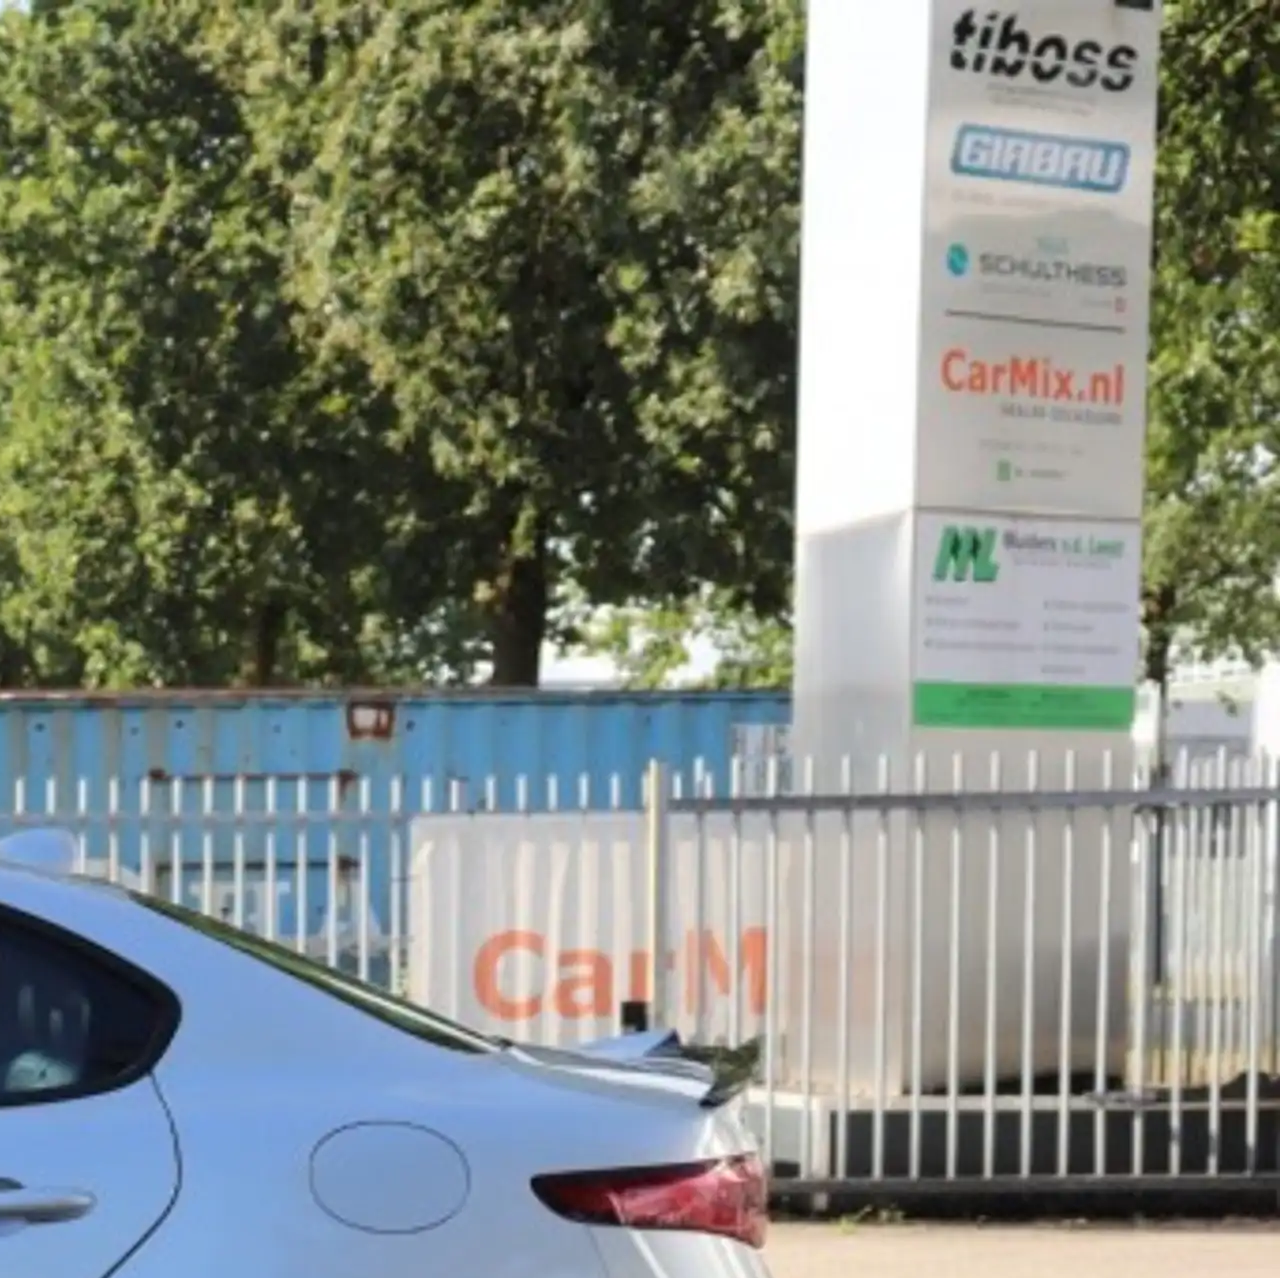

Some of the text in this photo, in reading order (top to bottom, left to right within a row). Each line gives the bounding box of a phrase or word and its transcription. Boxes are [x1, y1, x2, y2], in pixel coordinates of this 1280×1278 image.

[950, 9, 1137, 91] tiboss
[980, 253, 1126, 287] SCHULTHESS
[942, 349, 1124, 405] CarMix.nl
